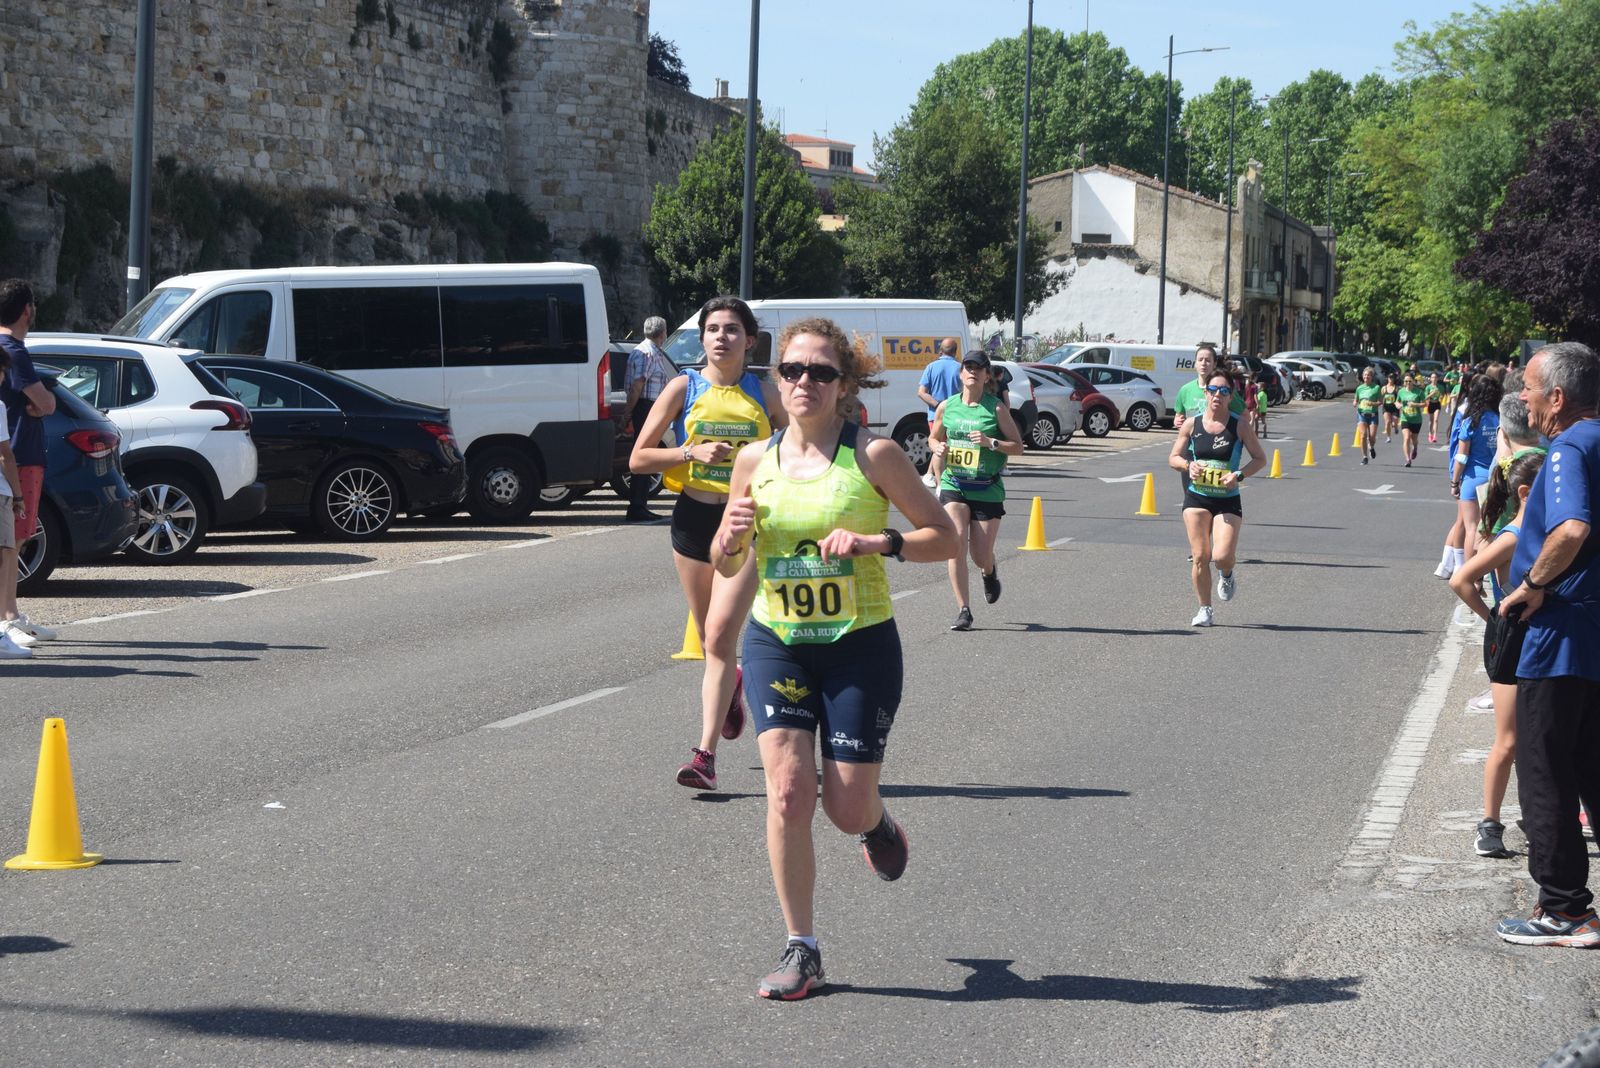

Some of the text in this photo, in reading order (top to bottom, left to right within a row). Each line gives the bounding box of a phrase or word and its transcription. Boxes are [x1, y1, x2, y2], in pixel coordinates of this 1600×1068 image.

[950, 449, 973, 465] 150
[710, 470, 727, 478] CAJA
[1202, 469, 1223, 485] 111
[788, 567, 842, 577] CAJA RURAL
[775, 582, 841, 617] 190
[790, 628, 815, 637] CAJA
[781, 706, 814, 719] AQUONA
